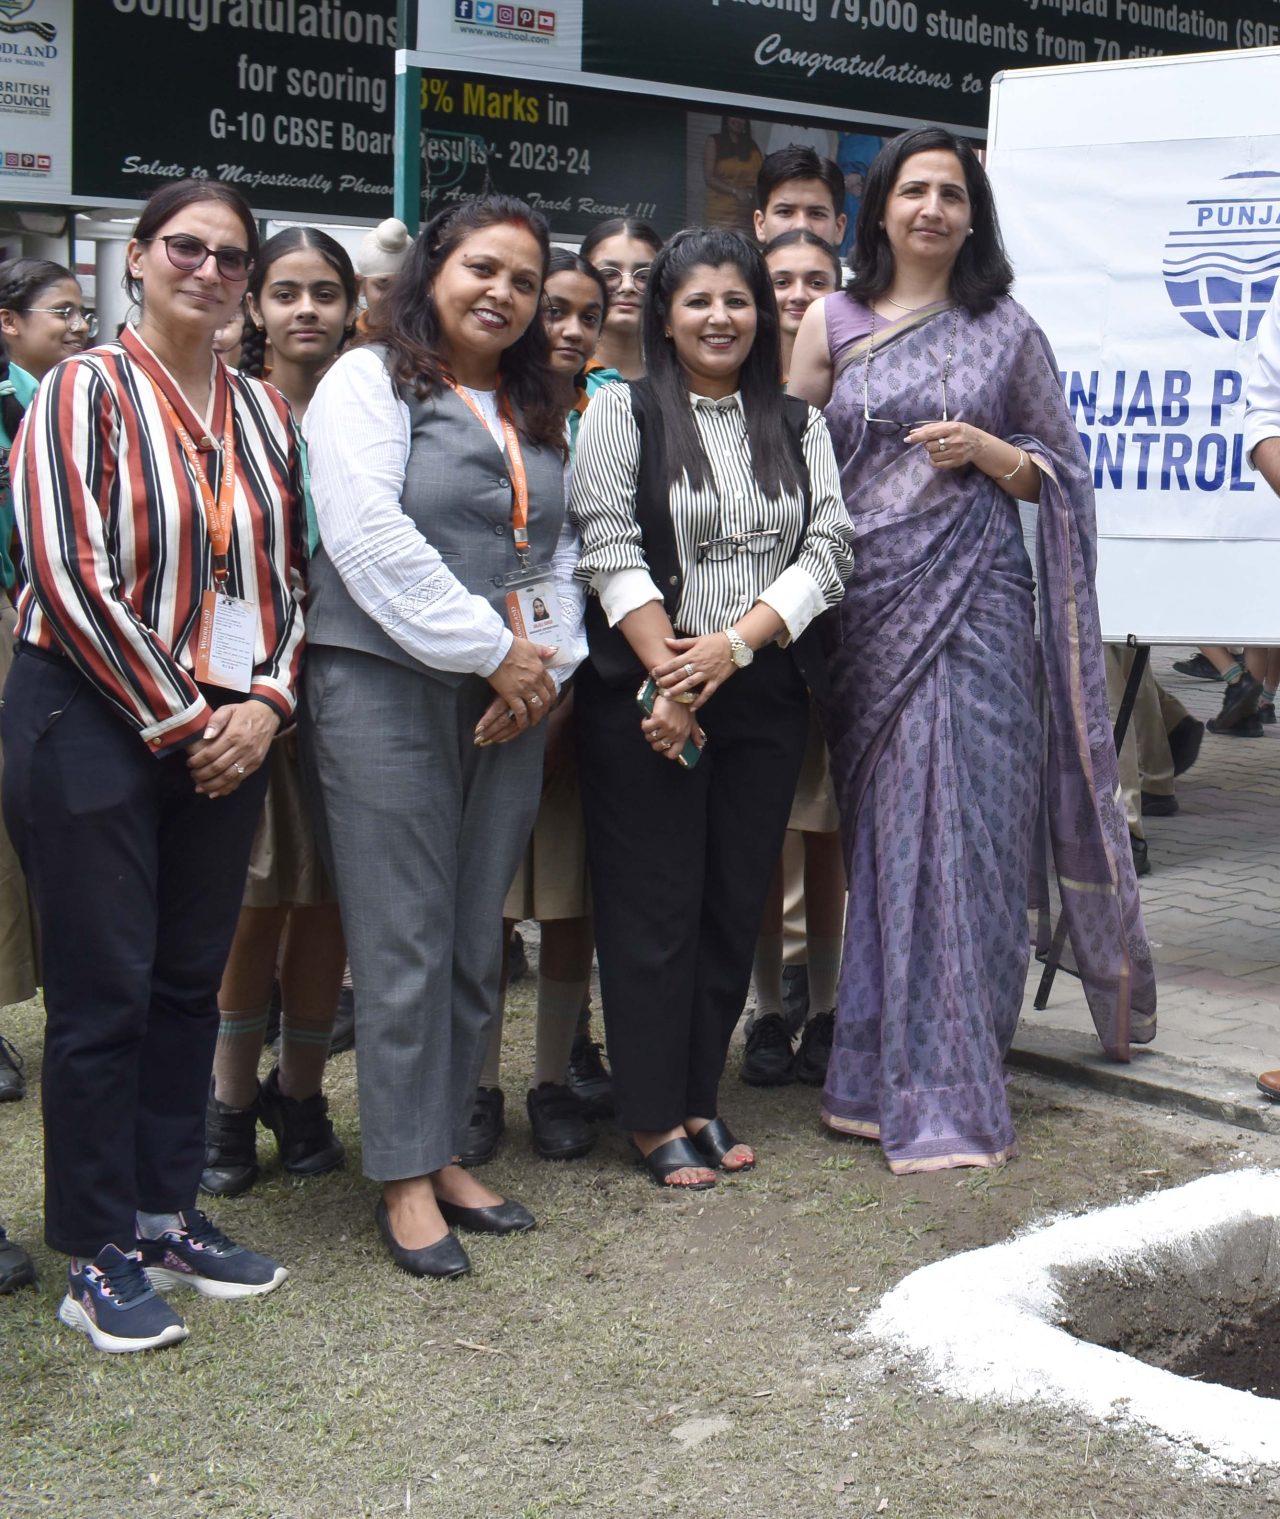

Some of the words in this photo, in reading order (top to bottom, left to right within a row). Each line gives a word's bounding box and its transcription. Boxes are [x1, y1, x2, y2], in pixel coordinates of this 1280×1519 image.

[829, 0, 918, 33] 79,000
[925, 10, 1029, 53] students
[1035, 28, 1087, 63] from
[1116, 0, 1228, 42] Foundation
[237, 54, 278, 93] for
[286, 65, 388, 113] scoring
[463, 82, 540, 124] Marks
[547, 93, 569, 127] in
[754, 33, 953, 90] Congratulations
[961, 73, 984, 93] to
[209, 108, 266, 143] G-10
[273, 115, 334, 150] CBSE
[509, 140, 591, 176] 2023-24
[121, 155, 185, 178] Salute
[192, 165, 209, 181] to
[216, 163, 333, 194] Majestically
[526, 191, 571, 212] Track
[578, 197, 630, 218] Record
[1059, 369, 1192, 428] NJAB
[1078, 432, 1256, 492] NTROL
